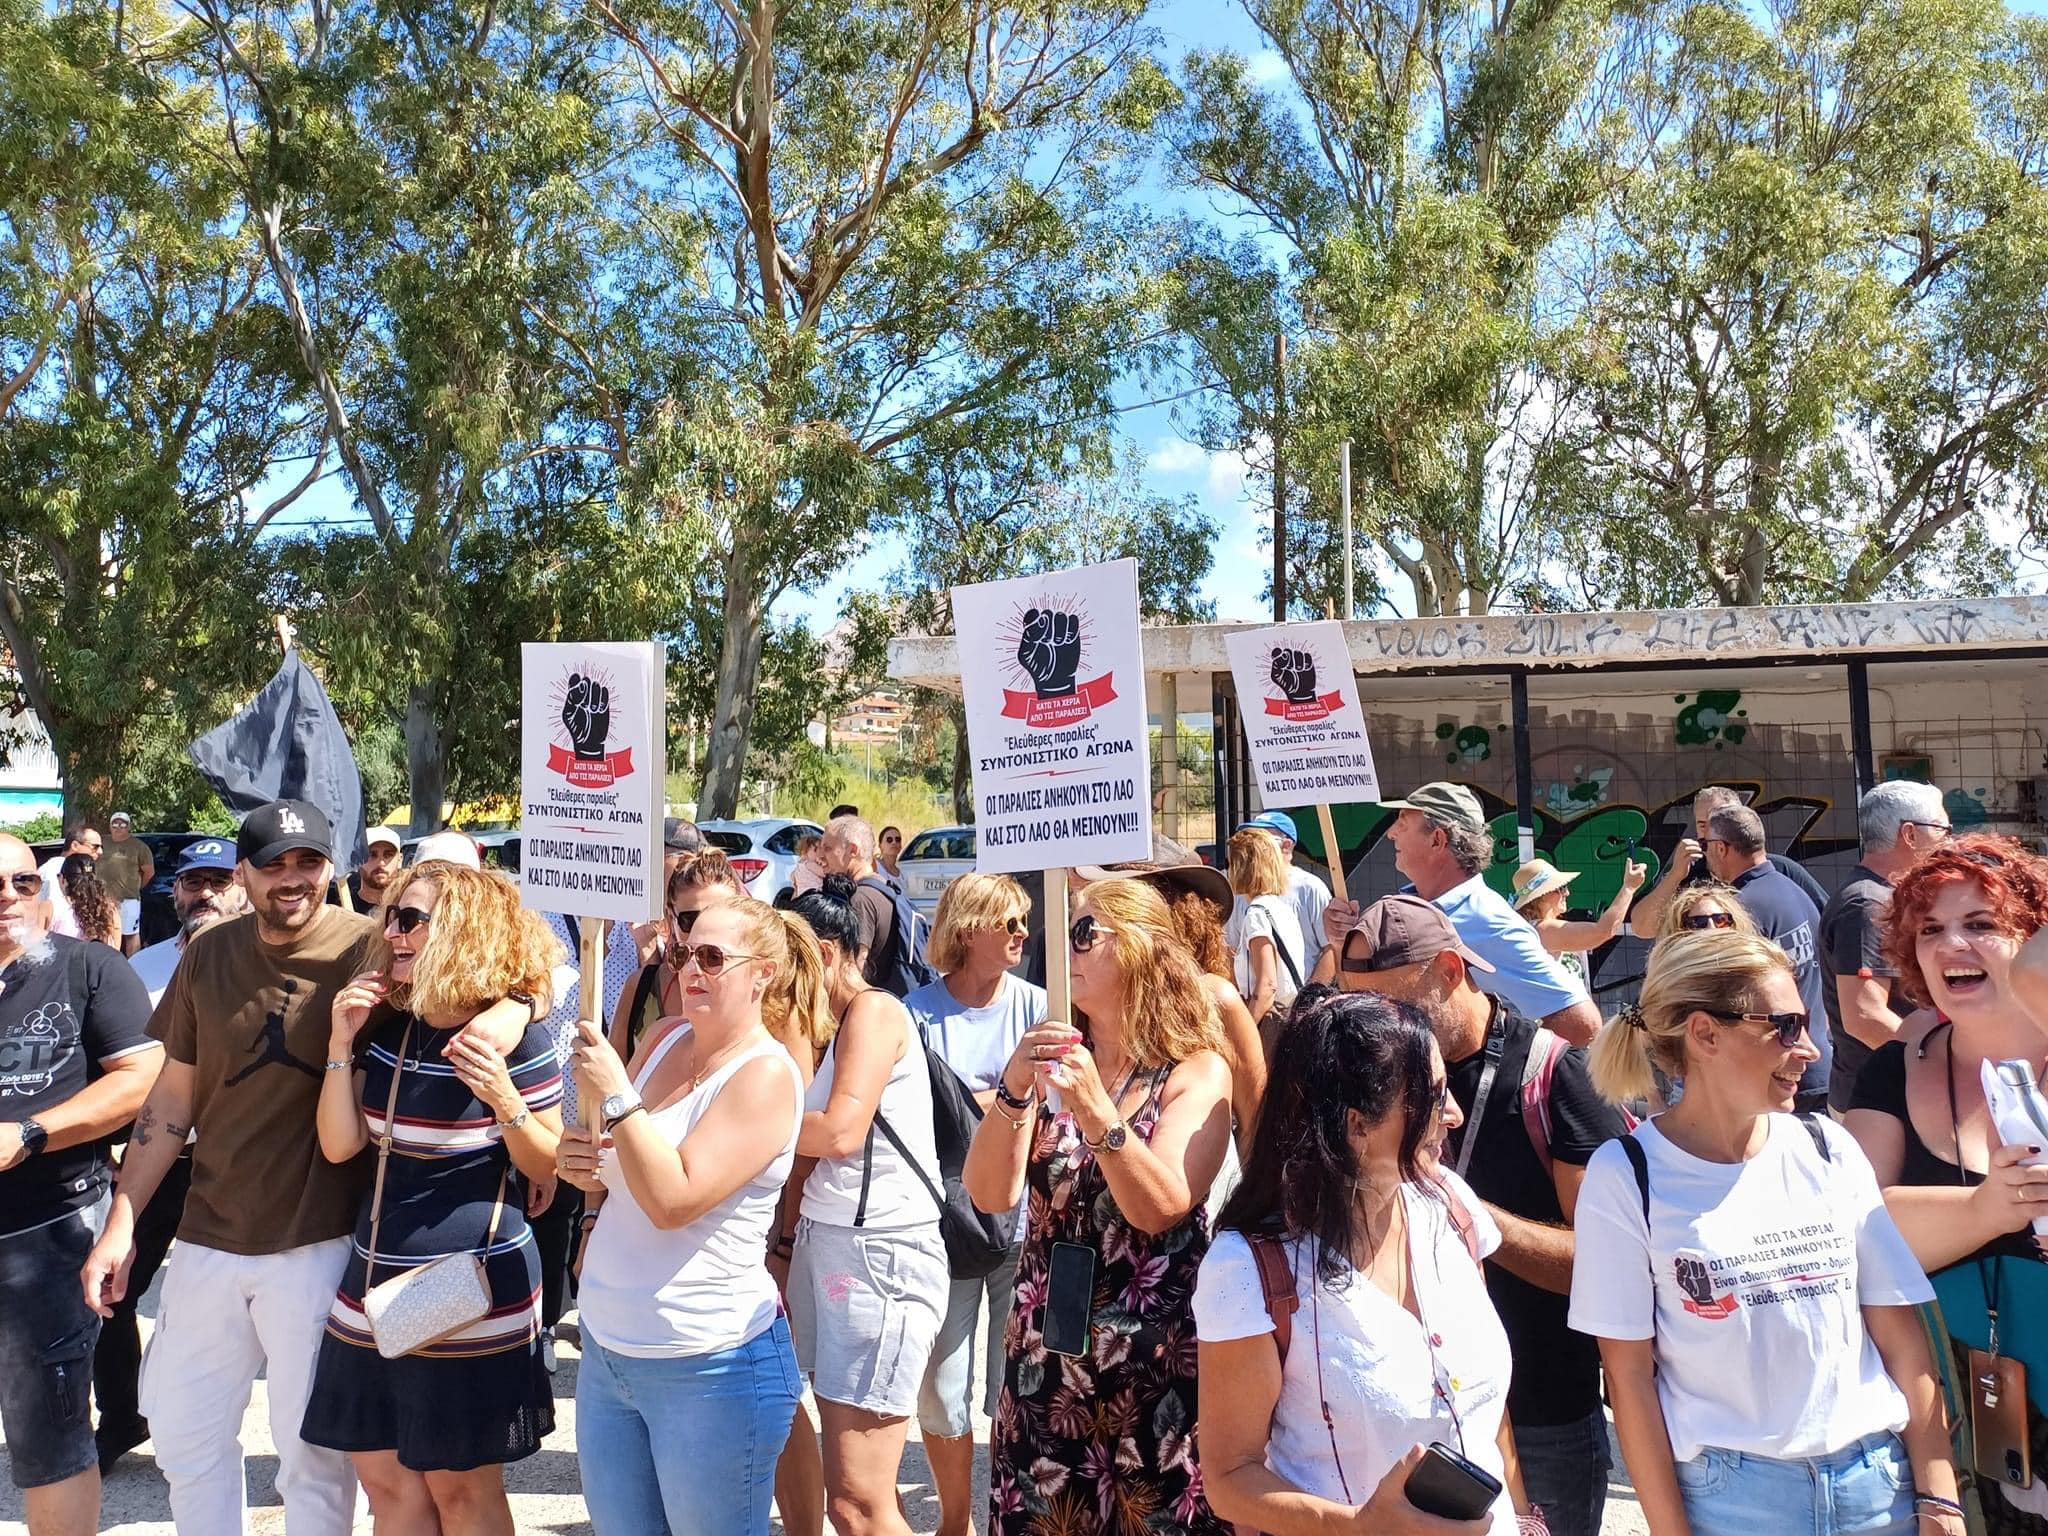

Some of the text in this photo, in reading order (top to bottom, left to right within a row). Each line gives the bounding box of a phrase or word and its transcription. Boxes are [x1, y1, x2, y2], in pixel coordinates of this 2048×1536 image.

[1255, 731, 1361, 748] ΣΥΝΤΟΝΙΣΤΙΚΟ ΑΓΩΝΑ
[981, 739, 1134, 771] ΣΥΝΤΟΝΙΣΤΙΚΟ ΑΓΩΝΑ
[1262, 754, 1366, 774] ΟΙ ΠΑΡΑΛΙΕΣ ΑΝΗΚΟΥΝ ΣΤΟ ΛΑΟ
[986, 778, 1134, 816] ΟΙ ΠΑΡΑΛΙΕΣ ΑΝΗΚΟΥΝ ΣΤΟ ΛΑΟ
[1265, 780, 1280, 792] ΚΑΙ
[1281, 779, 1296, 791] ΣΤΟ
[1299, 777, 1314, 789] ΛΑΟ
[1316, 776, 1326, 788] ΘΑ
[279, 808, 306, 834] LA
[528, 804, 643, 824] ΣΥΝΤΟΝΙΣΤΙΚΟ ΑΓΩΝΑ
[986, 812, 1139, 846] ΚΑΙ ΣΤΟ ΛΑΟ ΘΑ ΜΕΙΝΟΥΝ!!!
[530, 838, 642, 867] ΟΙ ΠΑΡΑΛΙΕΣ ΑΝΗΚΟΥΝ ΣΤΟ ΛΑΟ
[528, 867, 643, 897] ΚΑΙ ΣΤΟ ΛΑΟ ΘΑ ΜΕΙΝΟΥΝ!!!
[1753, 1222, 1834, 1246] ΚΑΤΩ ΤΑ ΧΕΡΙΑ!
[1710, 1258, 1724, 1272] ΟΙ
[1725, 1249, 1779, 1269] ΠΑΡΑΛΙΕΣ
[1780, 1239, 1832, 1258] ΑΝΗΚΟΥΝ
[1714, 1275, 1738, 1290] Είναι
